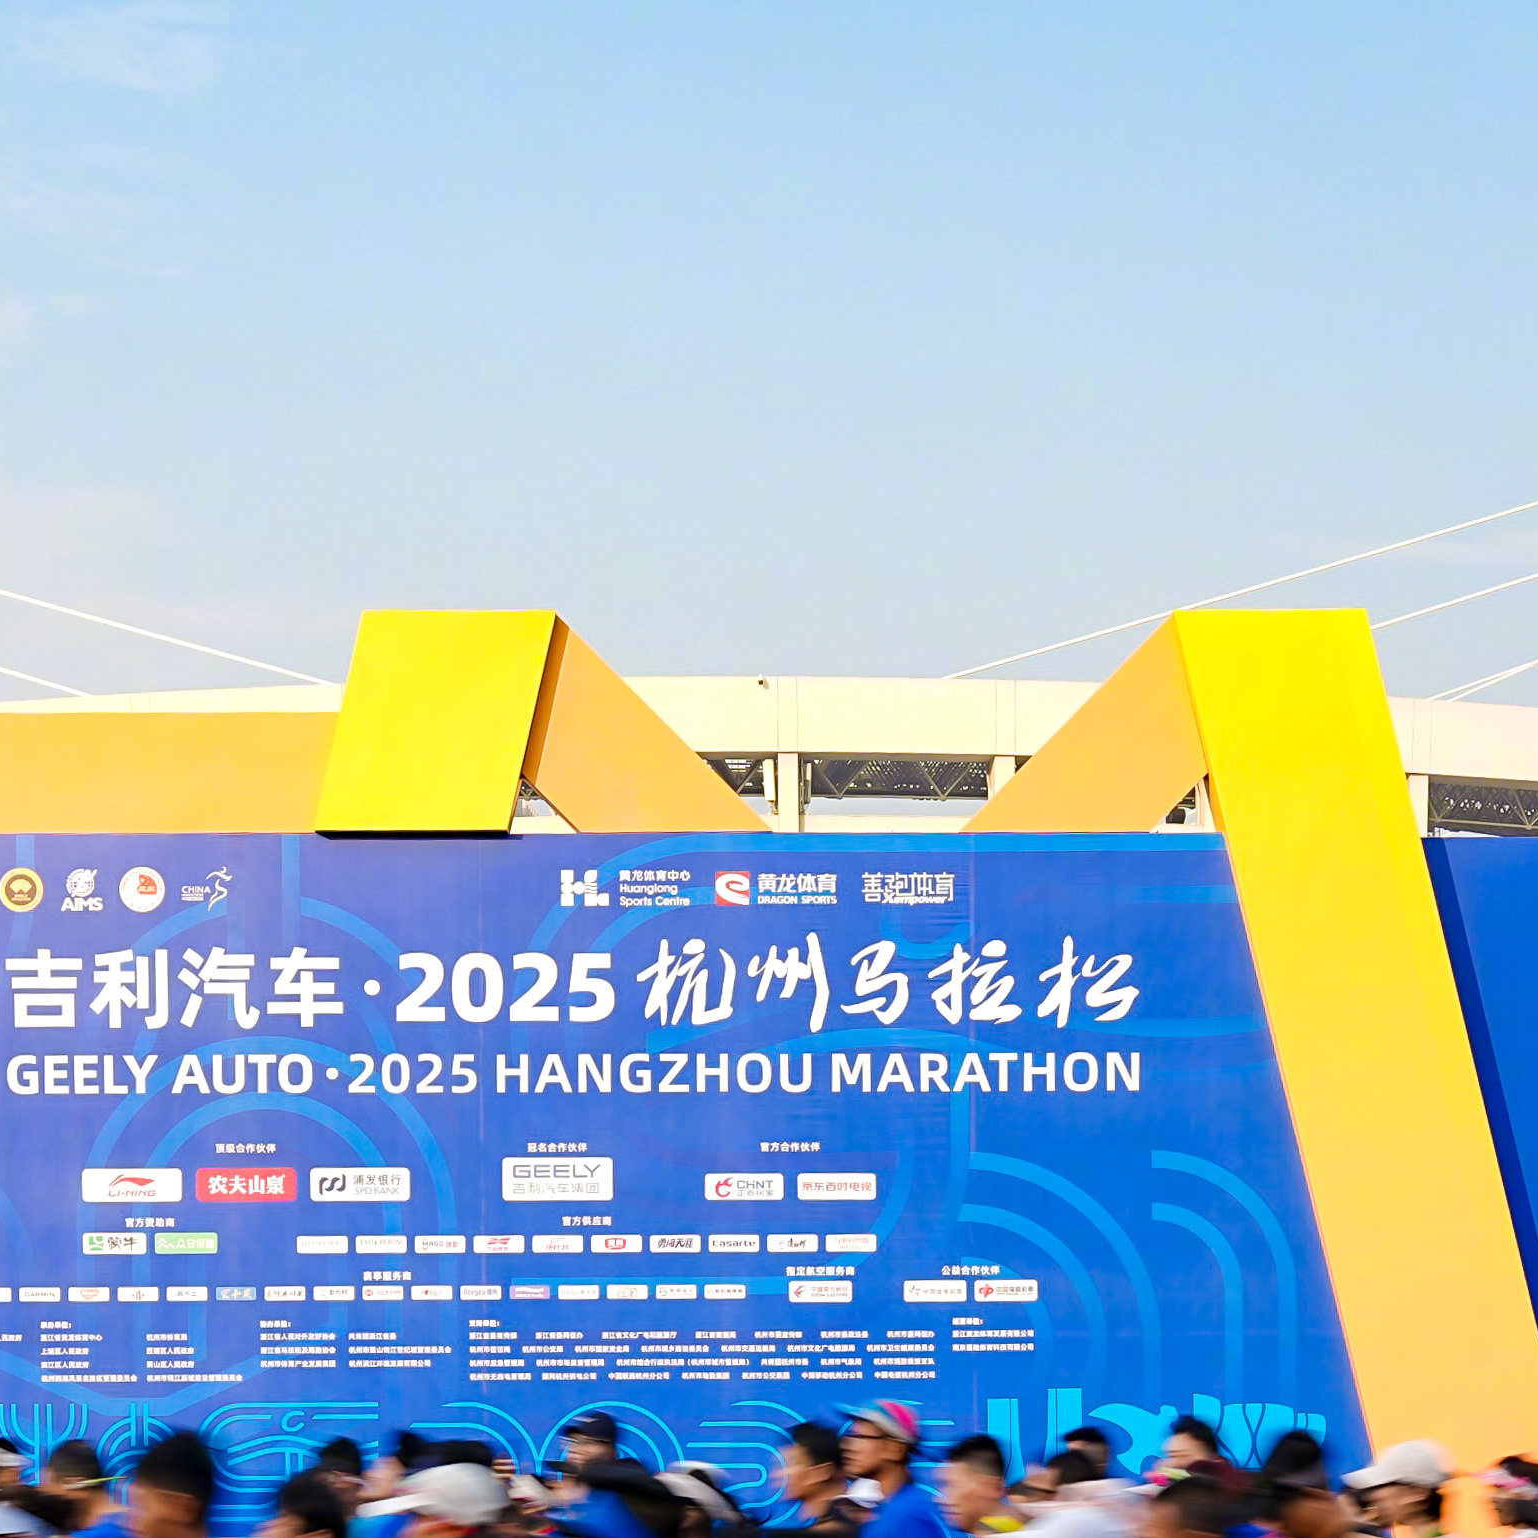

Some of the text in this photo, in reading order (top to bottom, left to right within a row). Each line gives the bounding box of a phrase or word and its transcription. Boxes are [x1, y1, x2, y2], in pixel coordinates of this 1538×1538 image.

[619, 870, 690, 881] 黄龙体育中心
[758, 873, 837, 893] 黄龙体育
[182, 886, 213, 896] CHINA
[620, 884, 678, 897] Huanglong
[61, 895, 103, 911] AIMS
[620, 894, 690, 907] Sports Centre
[758, 896, 837, 904] DRAGON SPORTS
[636, 932, 1141, 1033] 杭州马拉松
[7, 1055, 158, 1094] GEELY
[497, 1053, 811, 1093] HANGZHOU
[832, 1052, 1140, 1092] MARATHON
[215, 1143, 276, 1153] 顶级合作伙伴
[528, 1142, 587, 1152] 冠名合作伙伴
[760, 1142, 820, 1152] 官方合作伙伴
[513, 1164, 601, 1179] GEELY
[208, 1175, 285, 1195] 农夫山泉
[353, 1174, 401, 1186] 浦发银行
[513, 1181, 599, 1194] 吉利汽车集团
[125, 1218, 174, 1227] 官方赞助商
[562, 1216, 611, 1226] 官方供应商
[786, 1266, 855, 1276] 指定航空服务商
[942, 1265, 1000, 1275] 公益合作伙伴
